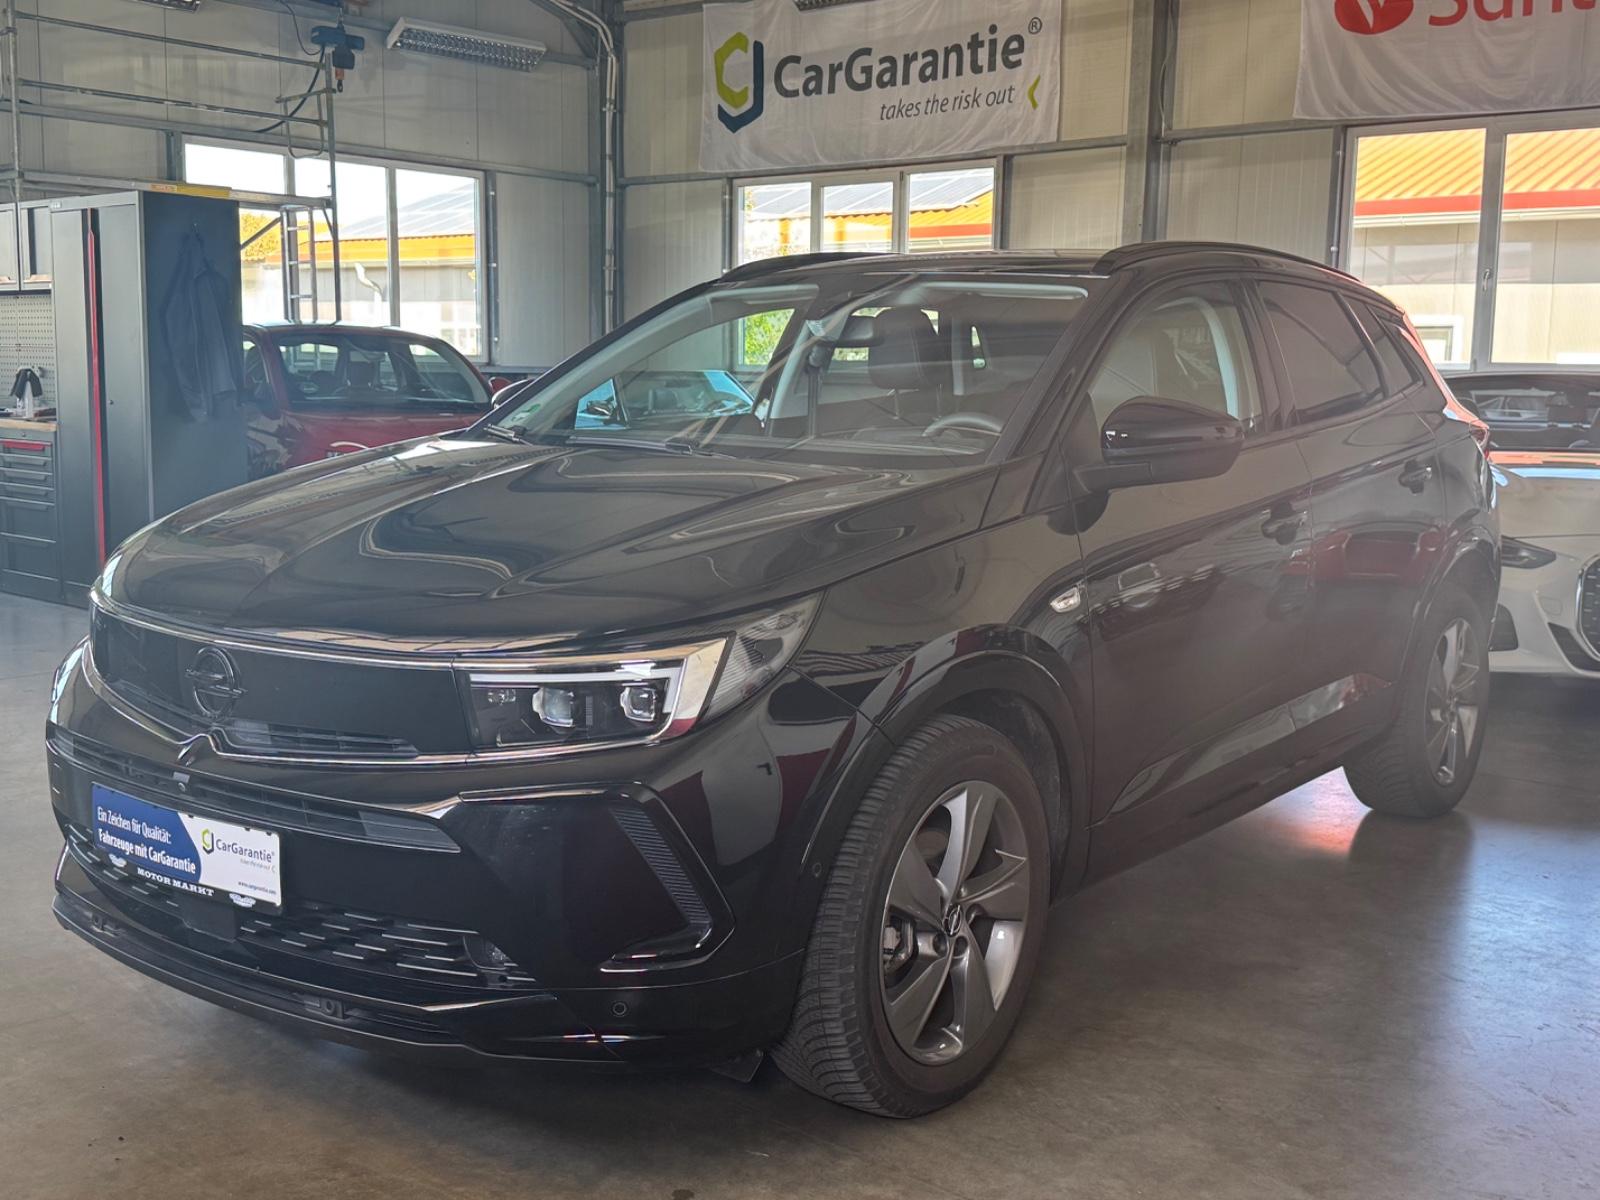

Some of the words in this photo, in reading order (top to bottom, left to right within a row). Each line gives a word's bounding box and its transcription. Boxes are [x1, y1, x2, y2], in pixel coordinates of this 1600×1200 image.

[880, 98, 922, 120] takes
[924, 94, 949, 115] the
[952, 87, 982, 111] risk
[985, 85, 1016, 107] out
[97, 806, 107, 822] Ein
[107, 810, 131, 831] Zeichen
[98, 828, 134, 855] Fahrzeuge
[134, 843, 147, 859] mit
[148, 846, 196, 874] CarGarantie
[137, 867, 171, 886] MOTOR
[172, 879, 215, 897] MARKT
